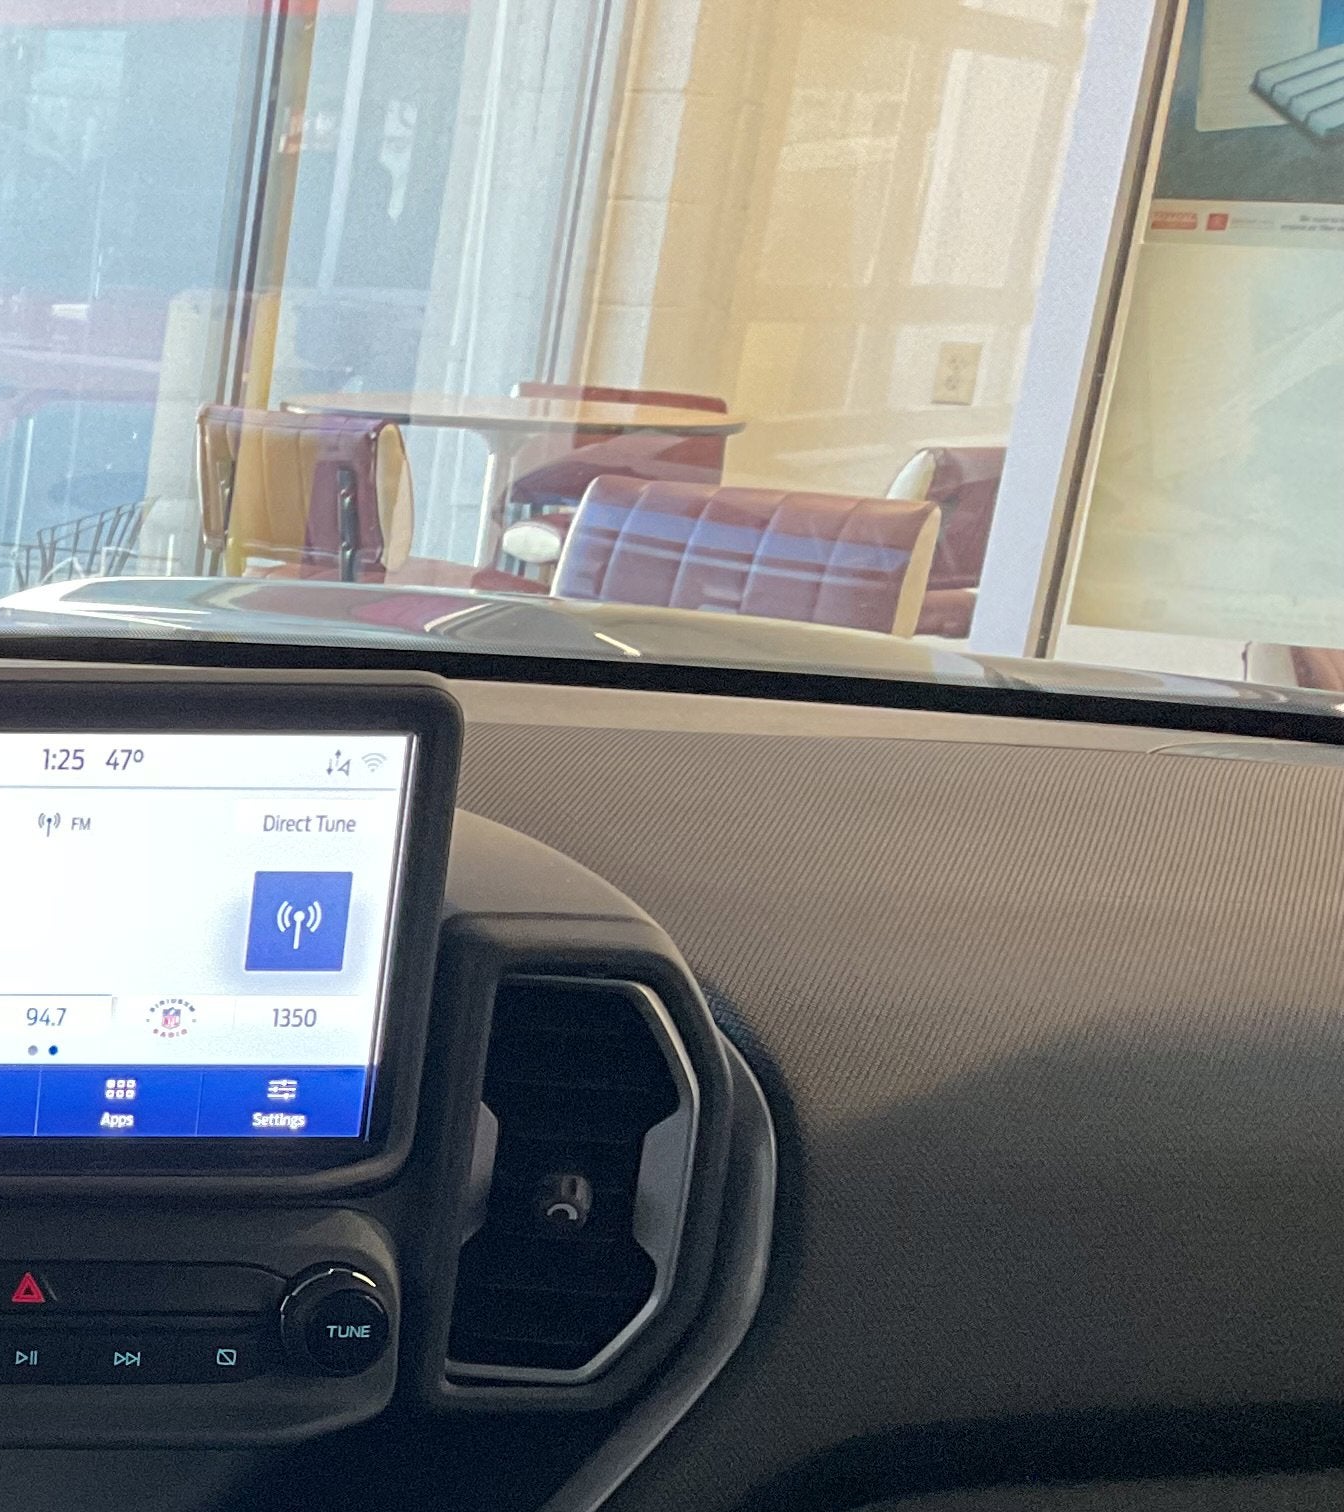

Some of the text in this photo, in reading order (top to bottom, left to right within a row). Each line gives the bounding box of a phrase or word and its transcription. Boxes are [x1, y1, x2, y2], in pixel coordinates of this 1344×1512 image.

[44, 749, 84, 770] 1:25
[71, 817, 91, 830] FM
[263, 815, 356, 832] Direct Tune
[27, 1008, 66, 1026] 94.7
[273, 1008, 317, 1027] 1350
[100, 1112, 134, 1128] Apps
[252, 1112, 306, 1130] Settings
[327, 1325, 370, 1337] TUNE
